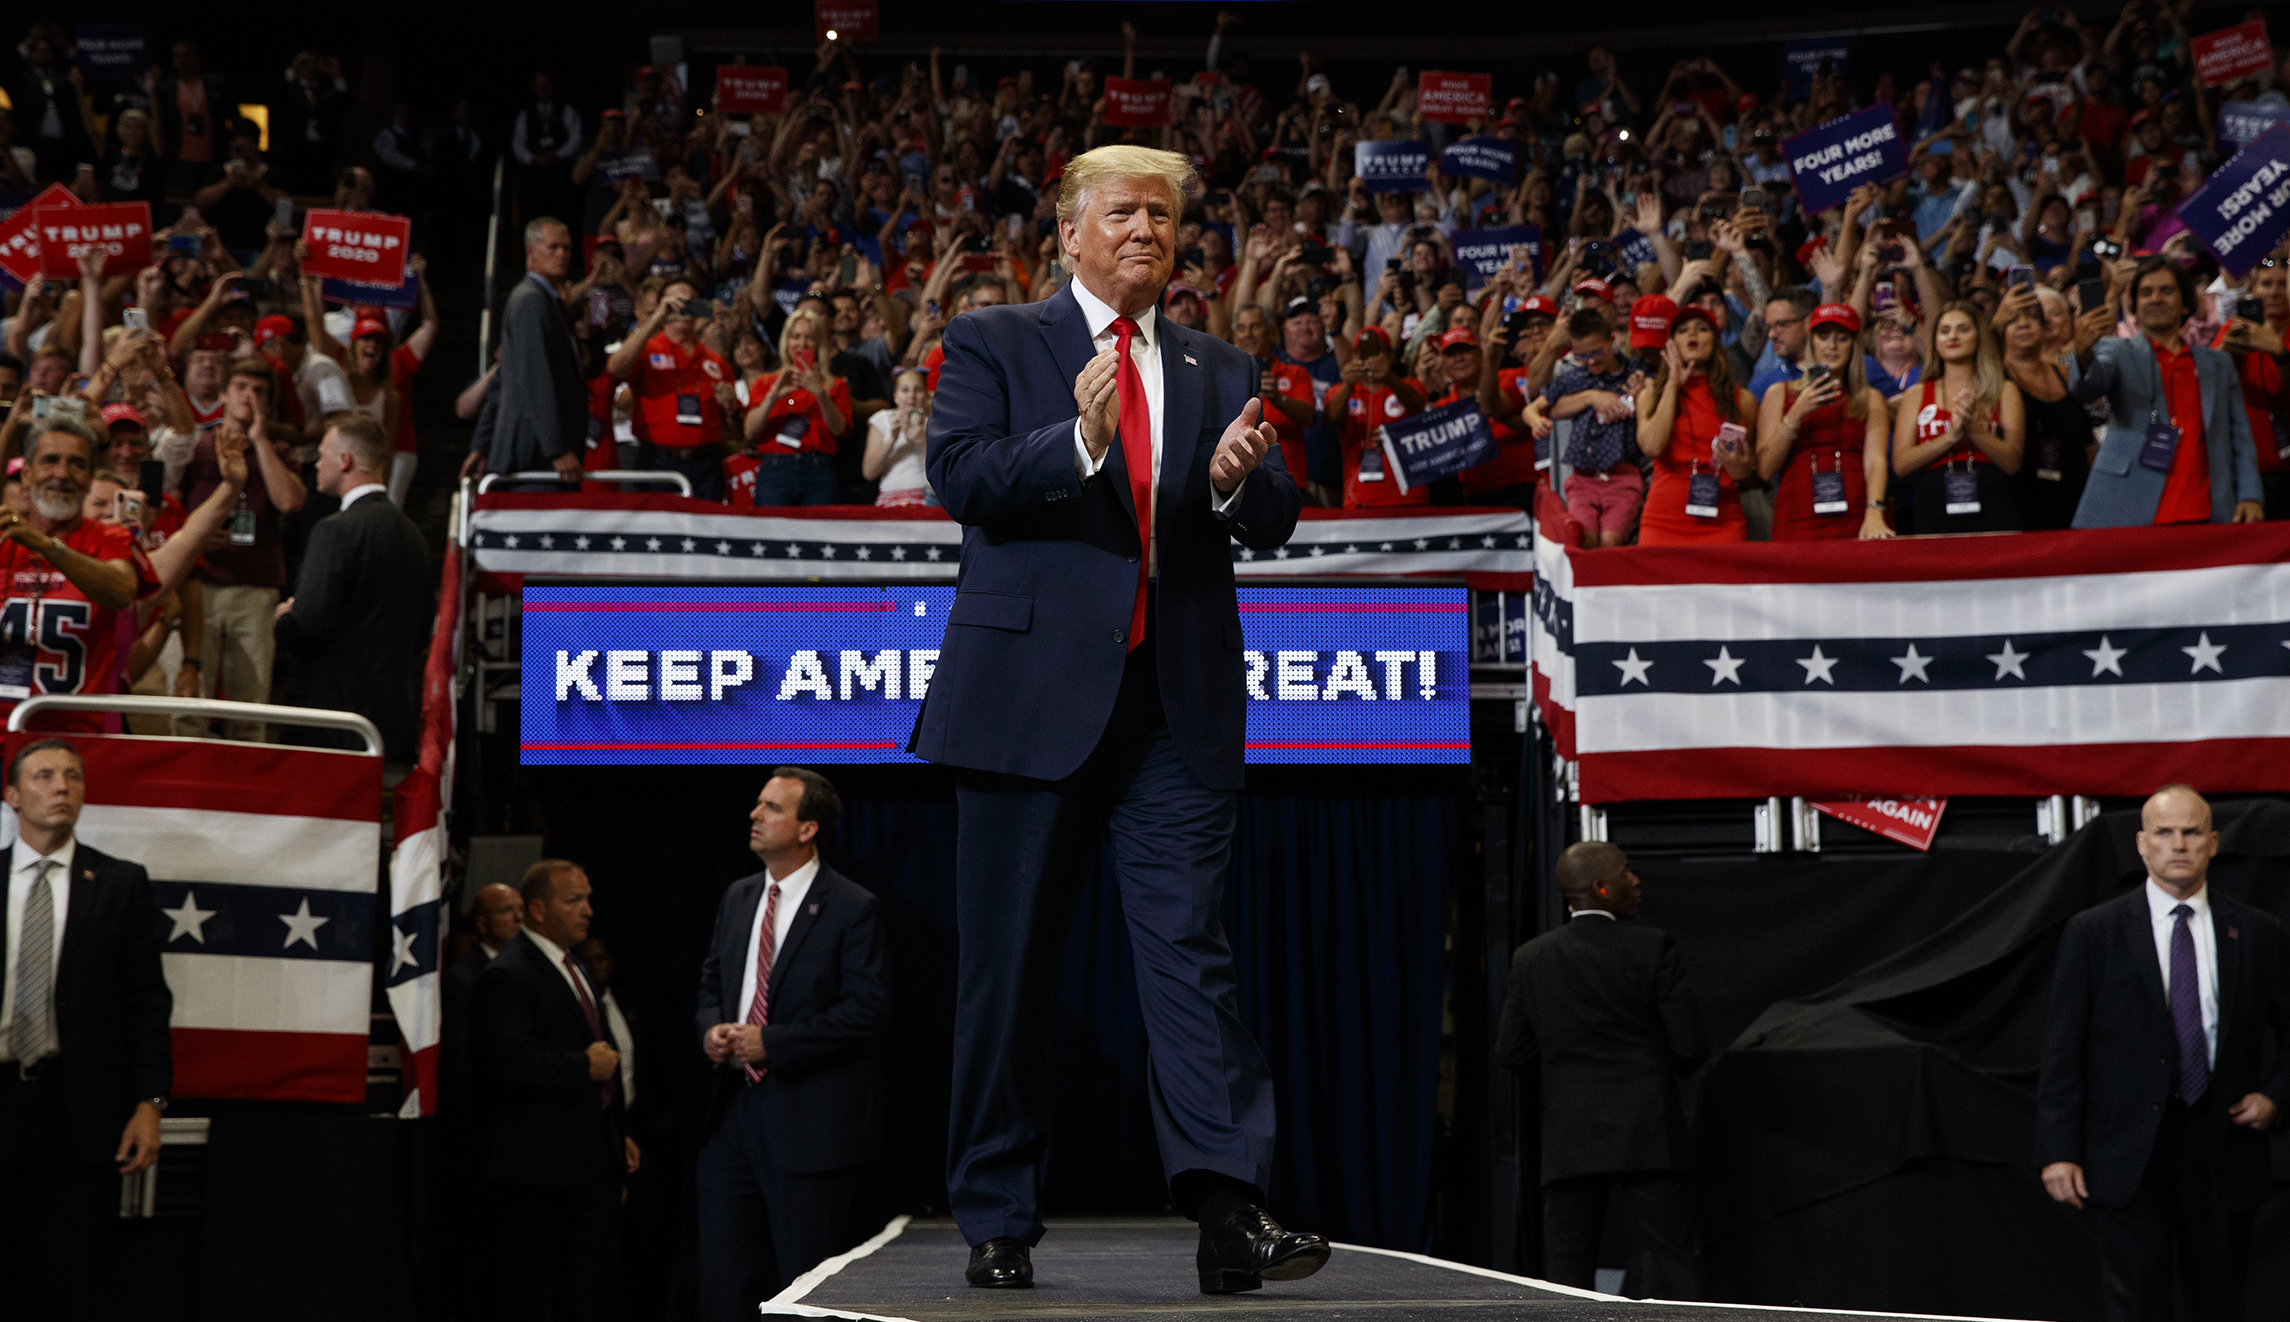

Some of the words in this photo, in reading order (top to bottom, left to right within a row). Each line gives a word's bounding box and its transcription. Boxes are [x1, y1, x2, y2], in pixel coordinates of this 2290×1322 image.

[1422, 88, 1485, 105] AMERICA
[1363, 153, 1428, 167] TRUMP
[1793, 143, 1844, 175] FOUR
[1844, 122, 1897, 156] MORE
[1818, 149, 1884, 186] YEARS!
[2214, 158, 2289, 221] YEARS!
[43, 222, 143, 243] TRUMP
[311, 226, 401, 251] TRUMP
[2212, 201, 2273, 257] MORE
[327, 243, 380, 264] 2020
[1457, 243, 1497, 261] FOUR
[1399, 412, 1481, 455] TRUMP
[555, 649, 753, 702] KEEP
[776, 649, 942, 702] AME
[1245, 649, 1438, 702] REAT!
[1867, 797, 1932, 830] AGAIN
